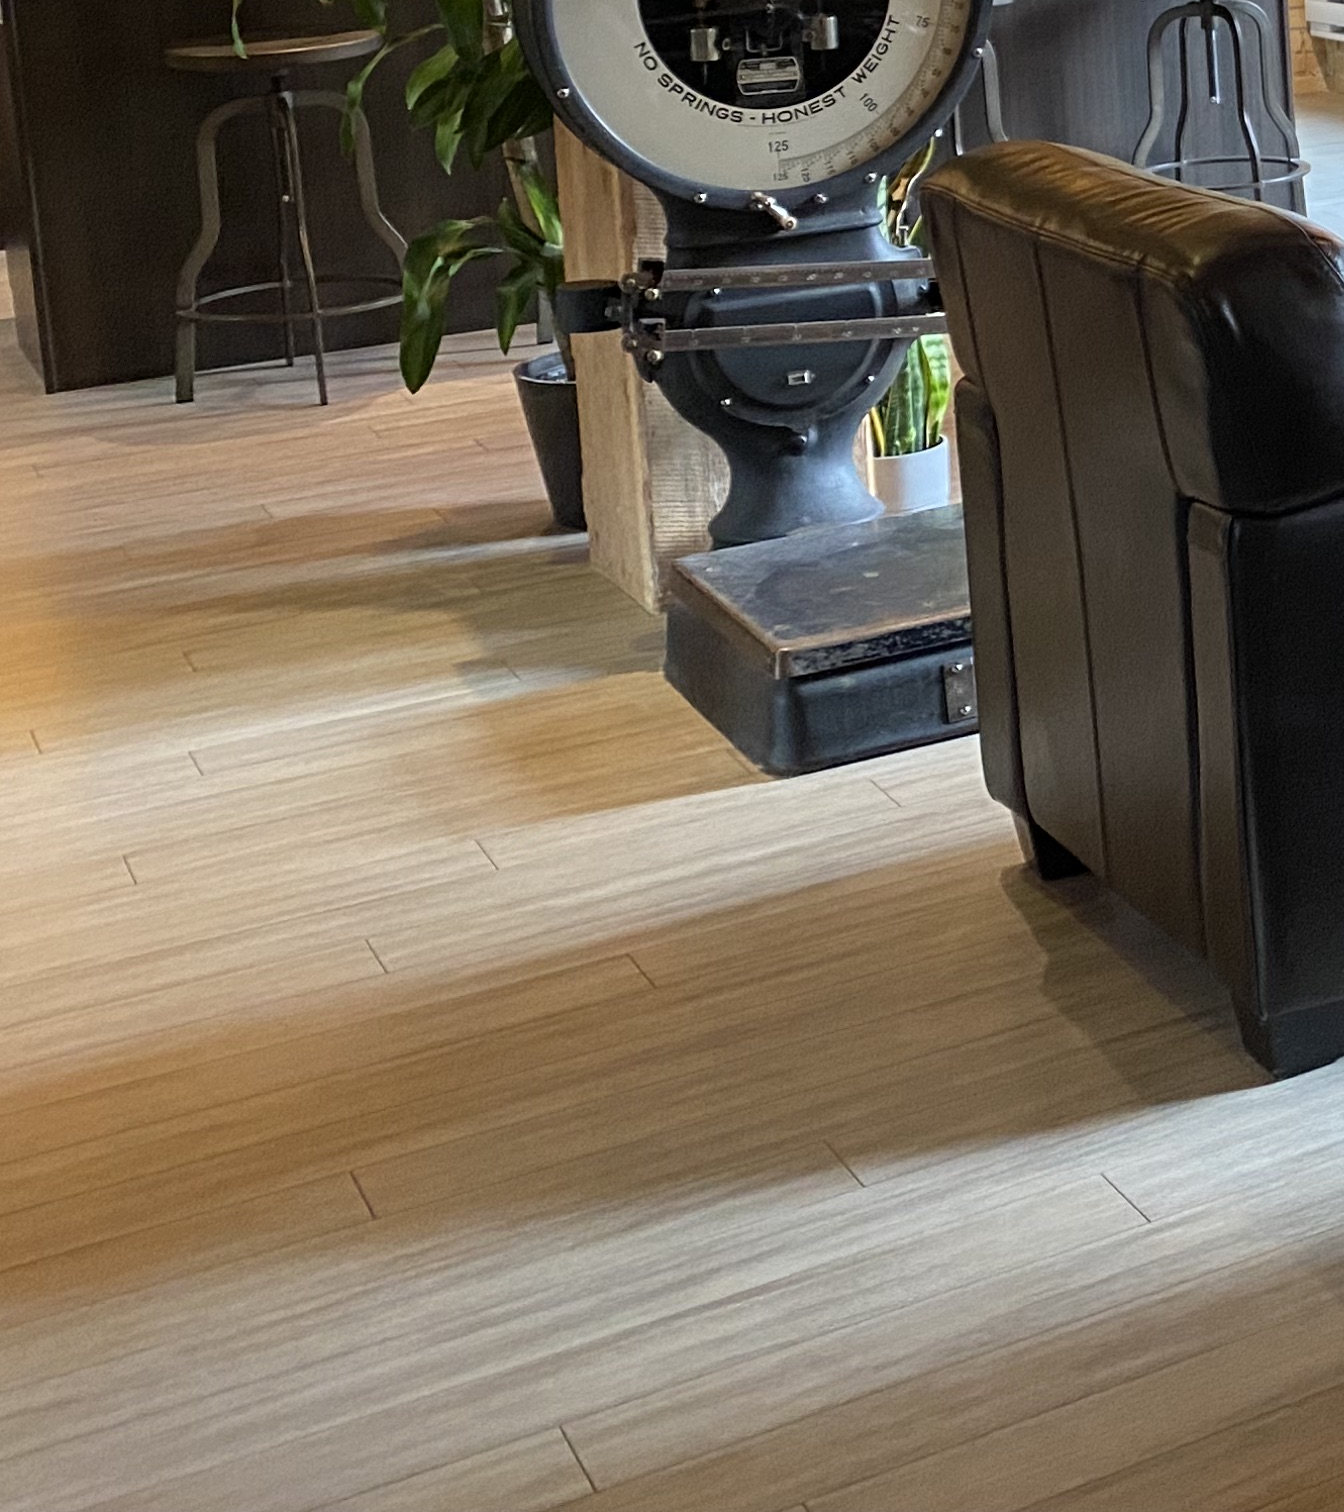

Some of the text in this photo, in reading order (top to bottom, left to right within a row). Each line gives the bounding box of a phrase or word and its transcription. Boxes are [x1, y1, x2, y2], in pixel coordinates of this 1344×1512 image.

[915, 15, 931, 28] 75
[633, 41, 658, 71] NO
[657, 73, 744, 123] SPRINGS
[761, 86, 846, 124] HONEST
[851, 15, 900, 84] WEIGHT
[859, 92, 878, 112] 100
[768, 140, 789, 152] 125
[772, 172, 789, 182] 125
